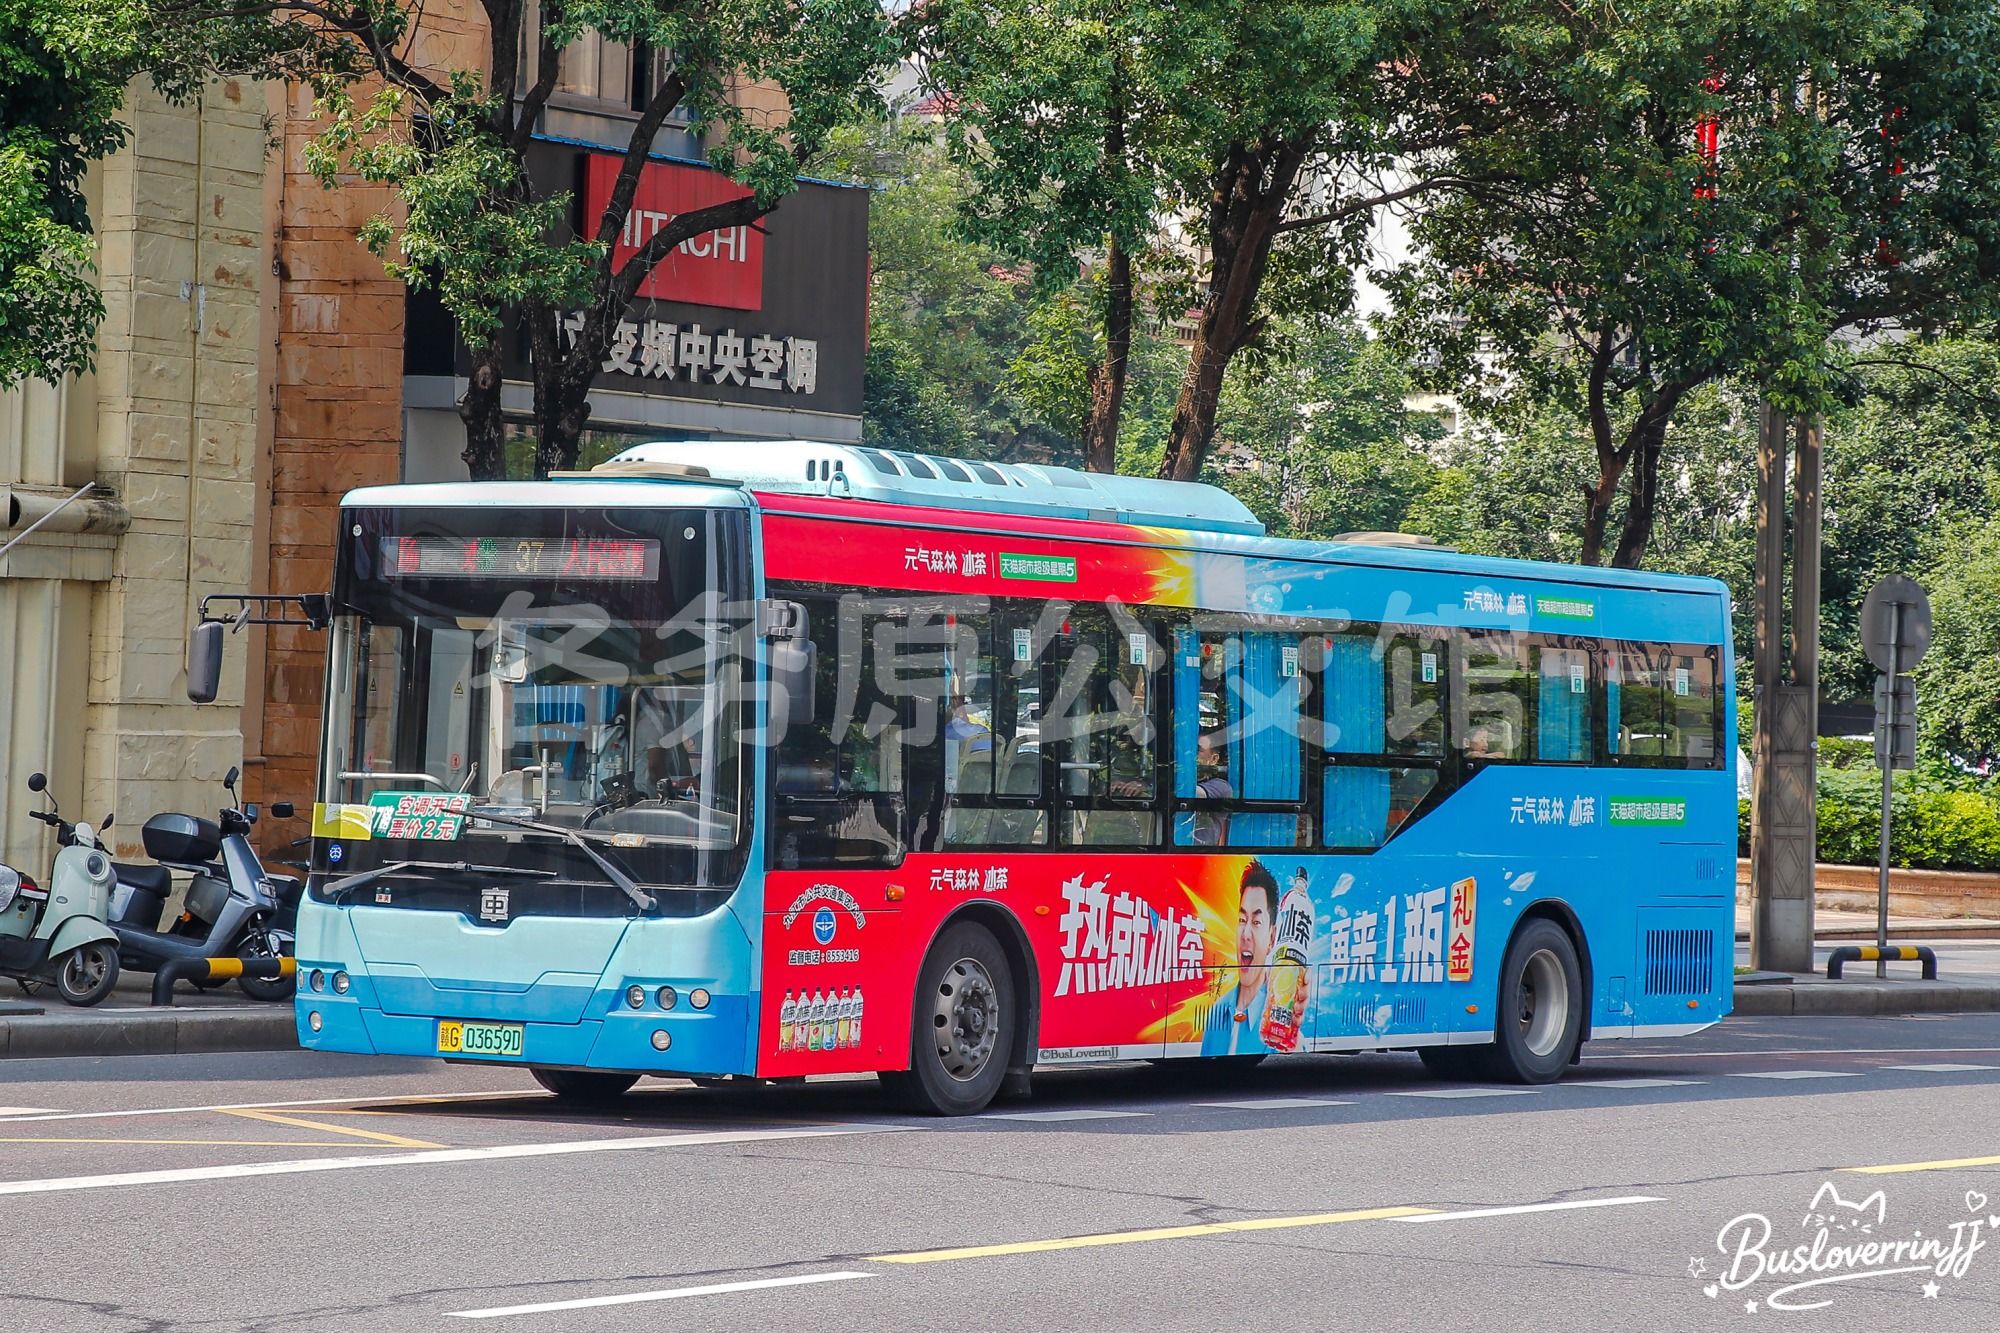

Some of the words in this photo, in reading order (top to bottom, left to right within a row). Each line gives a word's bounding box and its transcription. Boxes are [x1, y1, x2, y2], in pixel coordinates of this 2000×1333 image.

[529, 310, 818, 395] 变频中央空调
[515, 541, 545, 573] 37
[904, 547, 958, 575] 元气森林
[962, 549, 987, 577] 冰茶
[1001, 557, 1075, 578] 天猫超市超级星期5
[1463, 591, 1505, 614] 元气森林
[1506, 592, 1527, 616] 冰茶
[1510, 795, 1565, 826] 元气森林
[1568, 794, 1595, 827] 冰茶
[1609, 802, 1685, 821] 天猫超市超级星期5
[387, 818, 455, 840] 票价2元
[929, 868, 980, 892] 元气森林
[983, 865, 1009, 893] 冰茶
[1054, 871, 1206, 998] 热就冰茶
[1278, 903, 1313, 951] 冰茶
[1331, 886, 1447, 984] 再来1瓶
[1451, 888, 1473, 976] 礼金
[466, 1028, 521, 1051] 03659D
